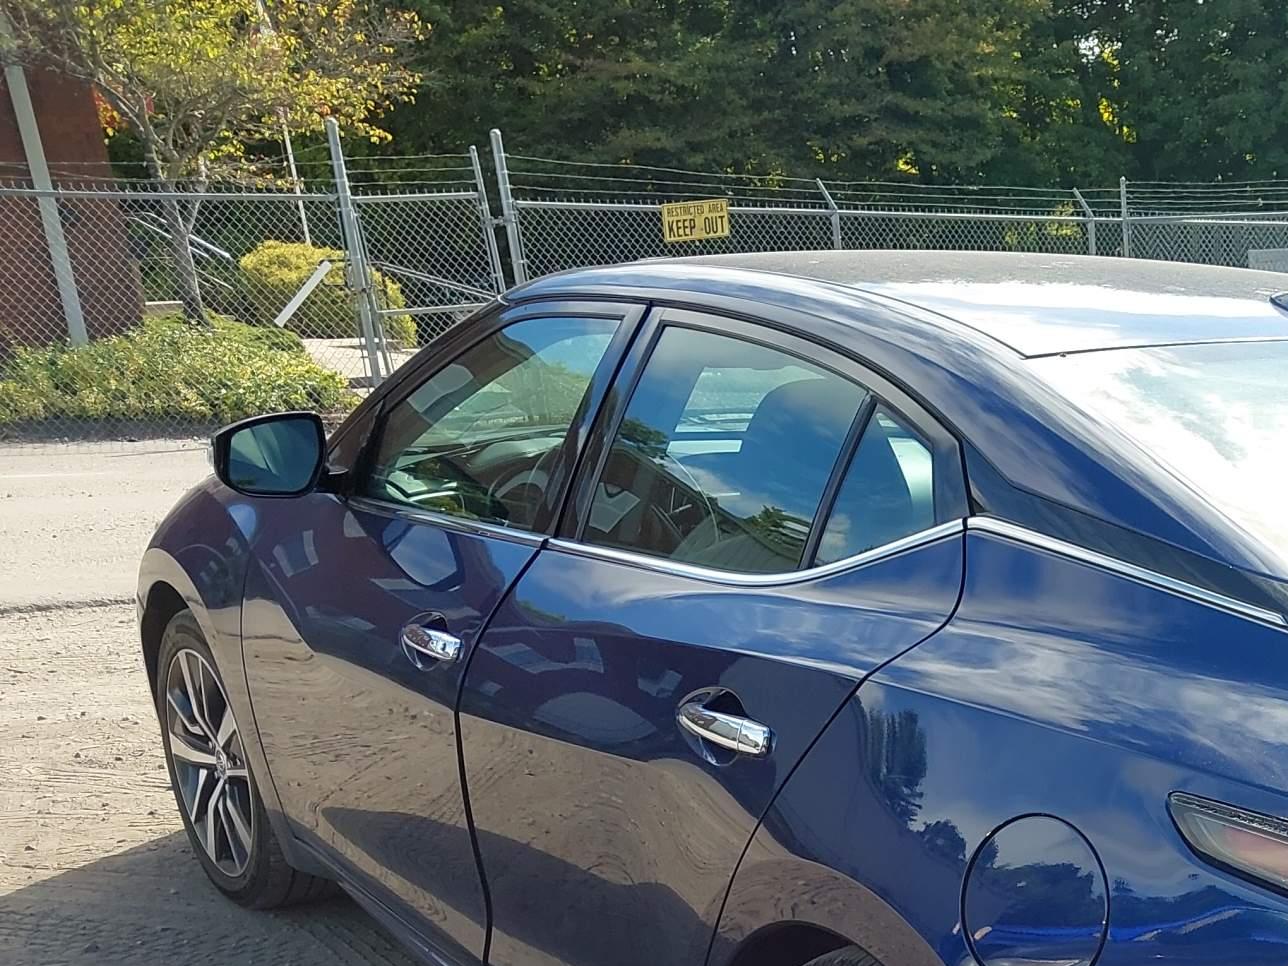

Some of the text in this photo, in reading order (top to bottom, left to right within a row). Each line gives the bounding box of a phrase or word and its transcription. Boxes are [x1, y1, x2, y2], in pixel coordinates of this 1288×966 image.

[666, 202, 724, 217] RESTRICTED AREA
[667, 215, 726, 238] KEEP OUT
